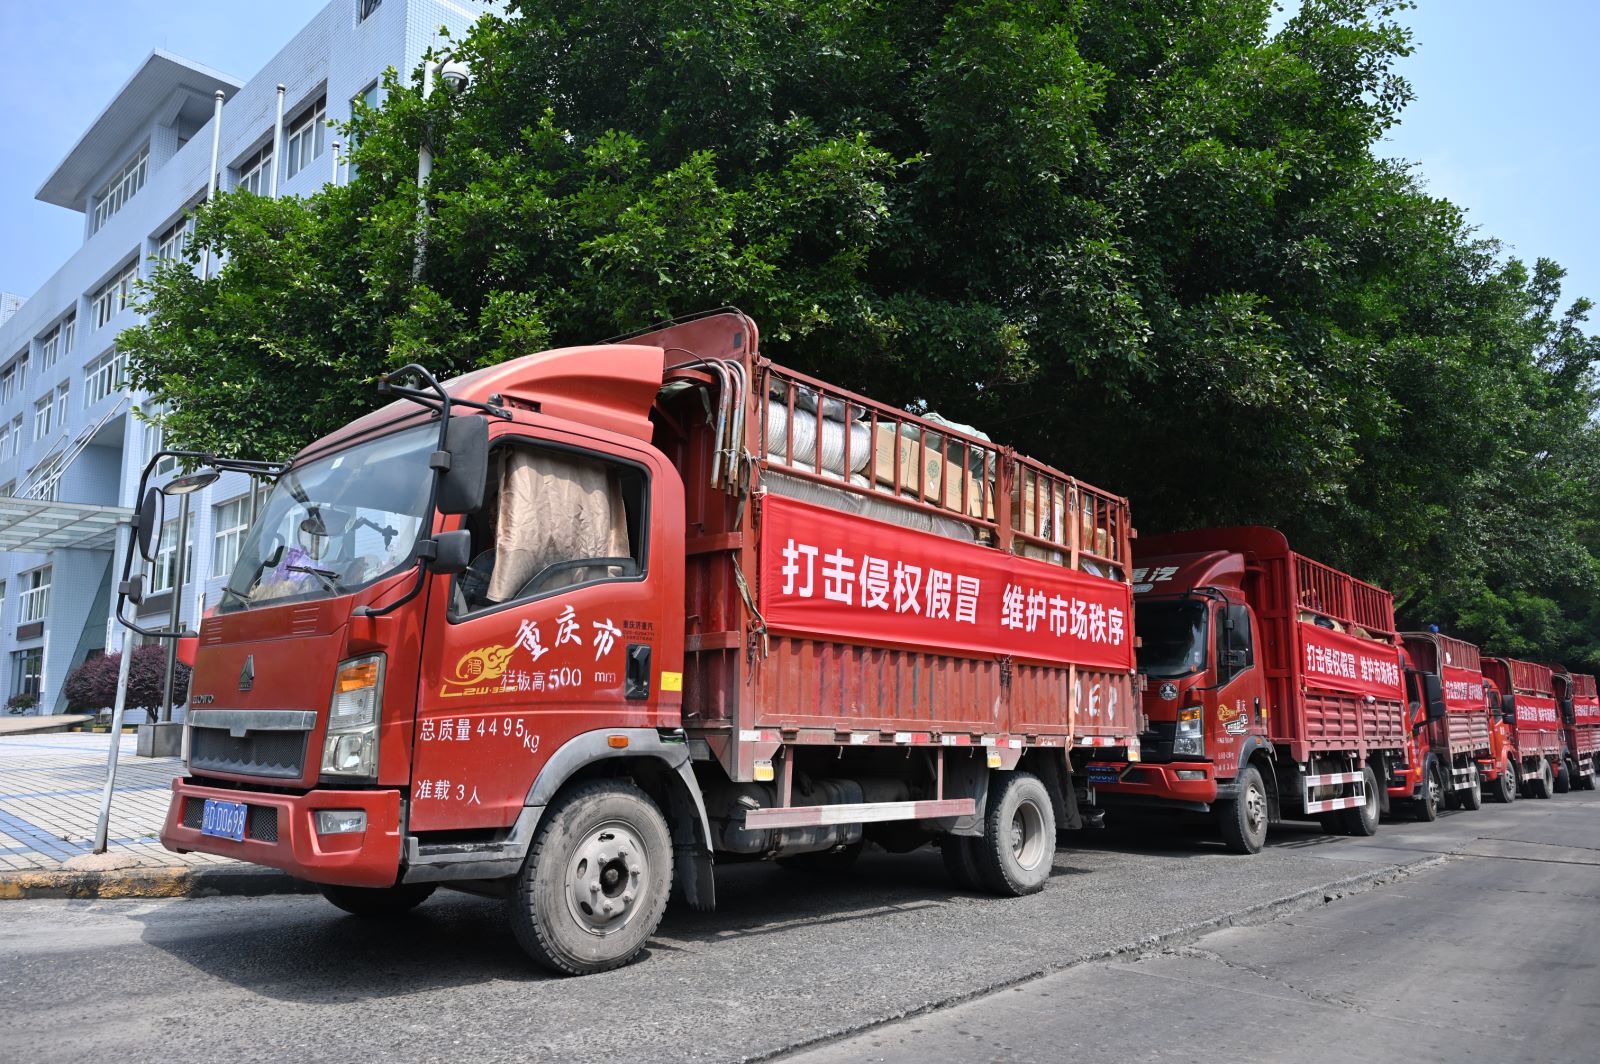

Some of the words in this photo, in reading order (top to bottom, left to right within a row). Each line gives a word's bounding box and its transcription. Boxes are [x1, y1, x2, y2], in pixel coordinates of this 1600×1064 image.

[782, 538, 980, 624] 打击侵权假冒
[1001, 583, 1124, 646] 维护市场秩序
[514, 604, 622, 662] 重庆市
[1307, 642, 1356, 679] 打击侵权假冒
[1360, 656, 1399, 686] 维护市场秩序
